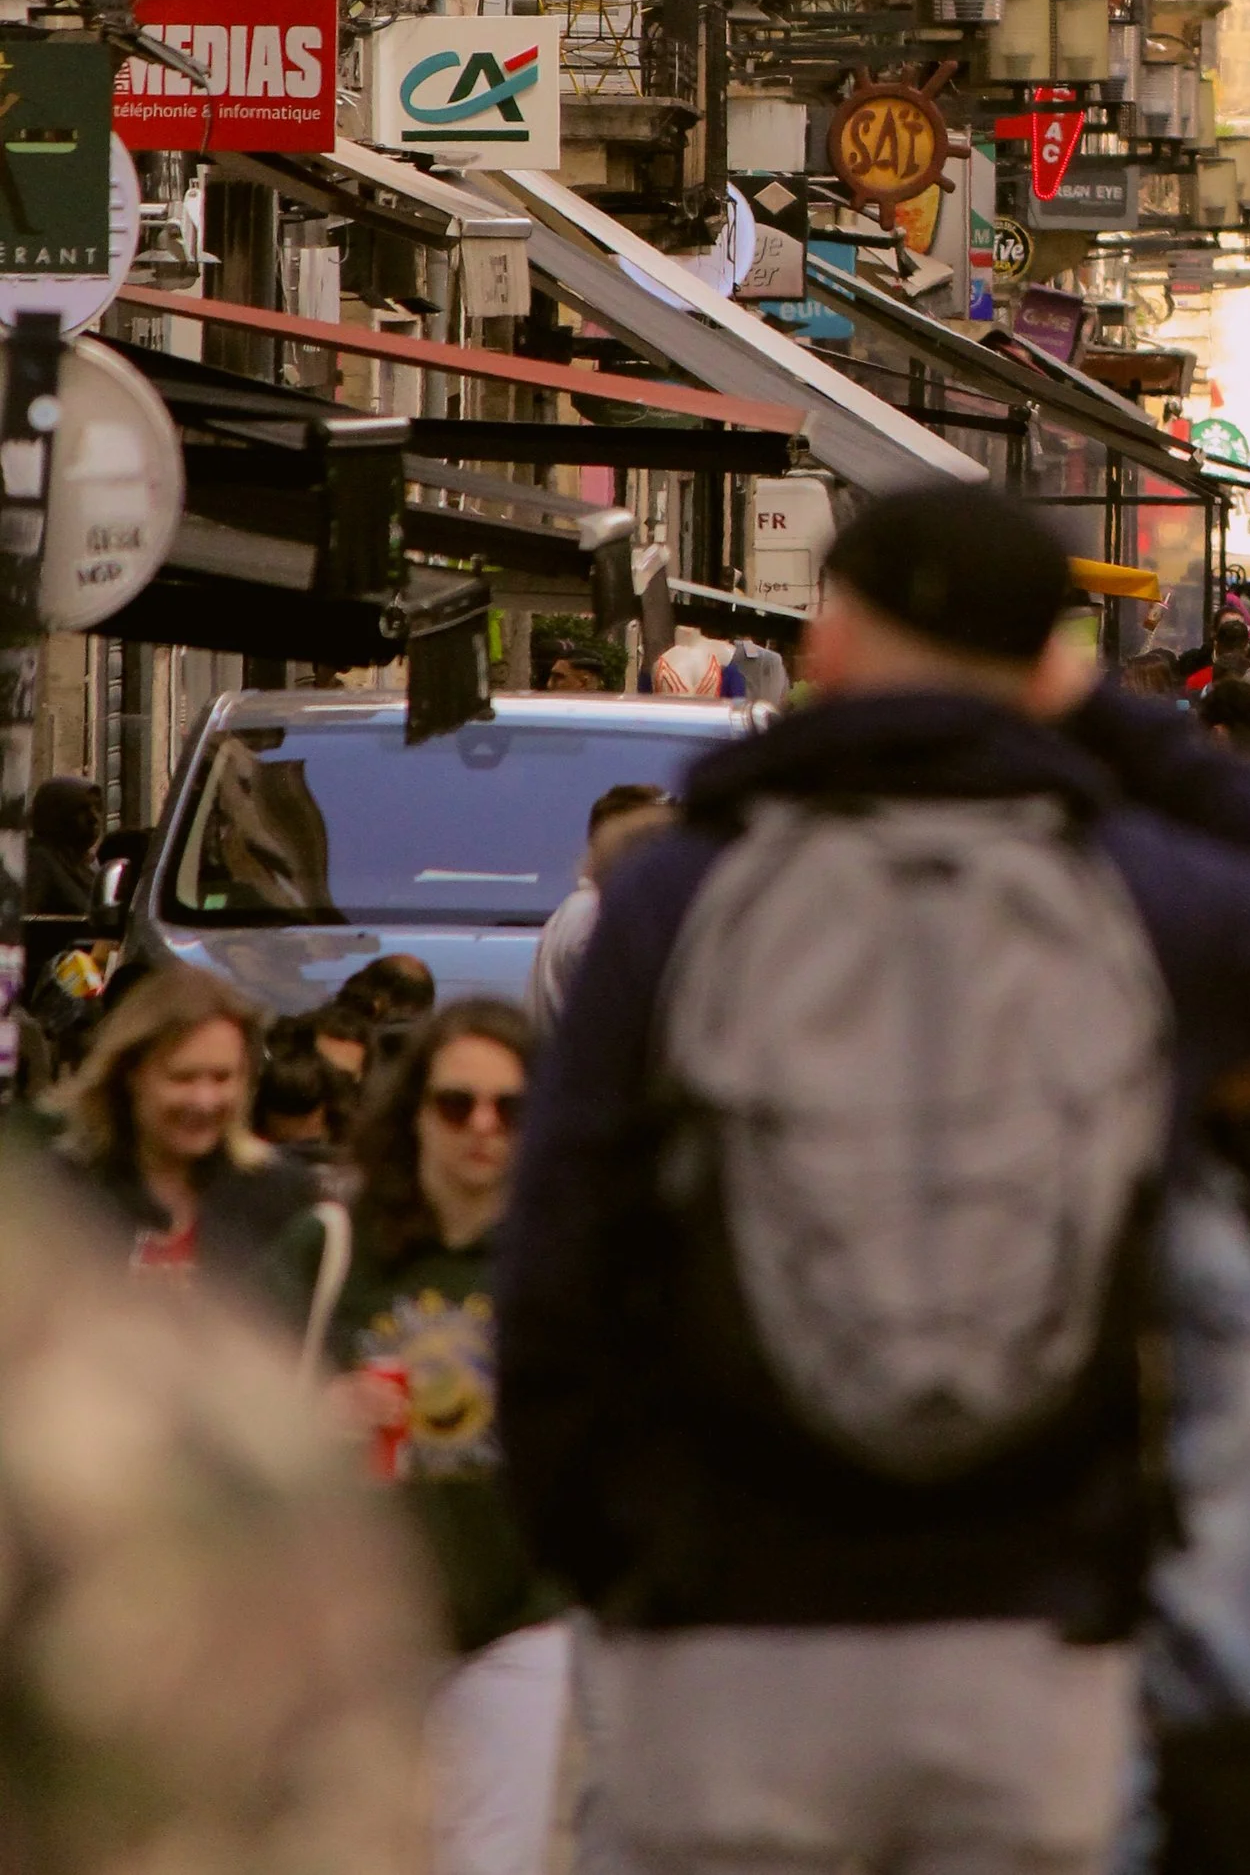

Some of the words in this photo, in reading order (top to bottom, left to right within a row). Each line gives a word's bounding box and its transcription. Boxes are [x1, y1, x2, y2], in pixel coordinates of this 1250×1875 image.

[113, 102, 197, 121] téléphonie
[219, 104, 322, 124] informatique
[1096, 185, 1123, 200] EYE
